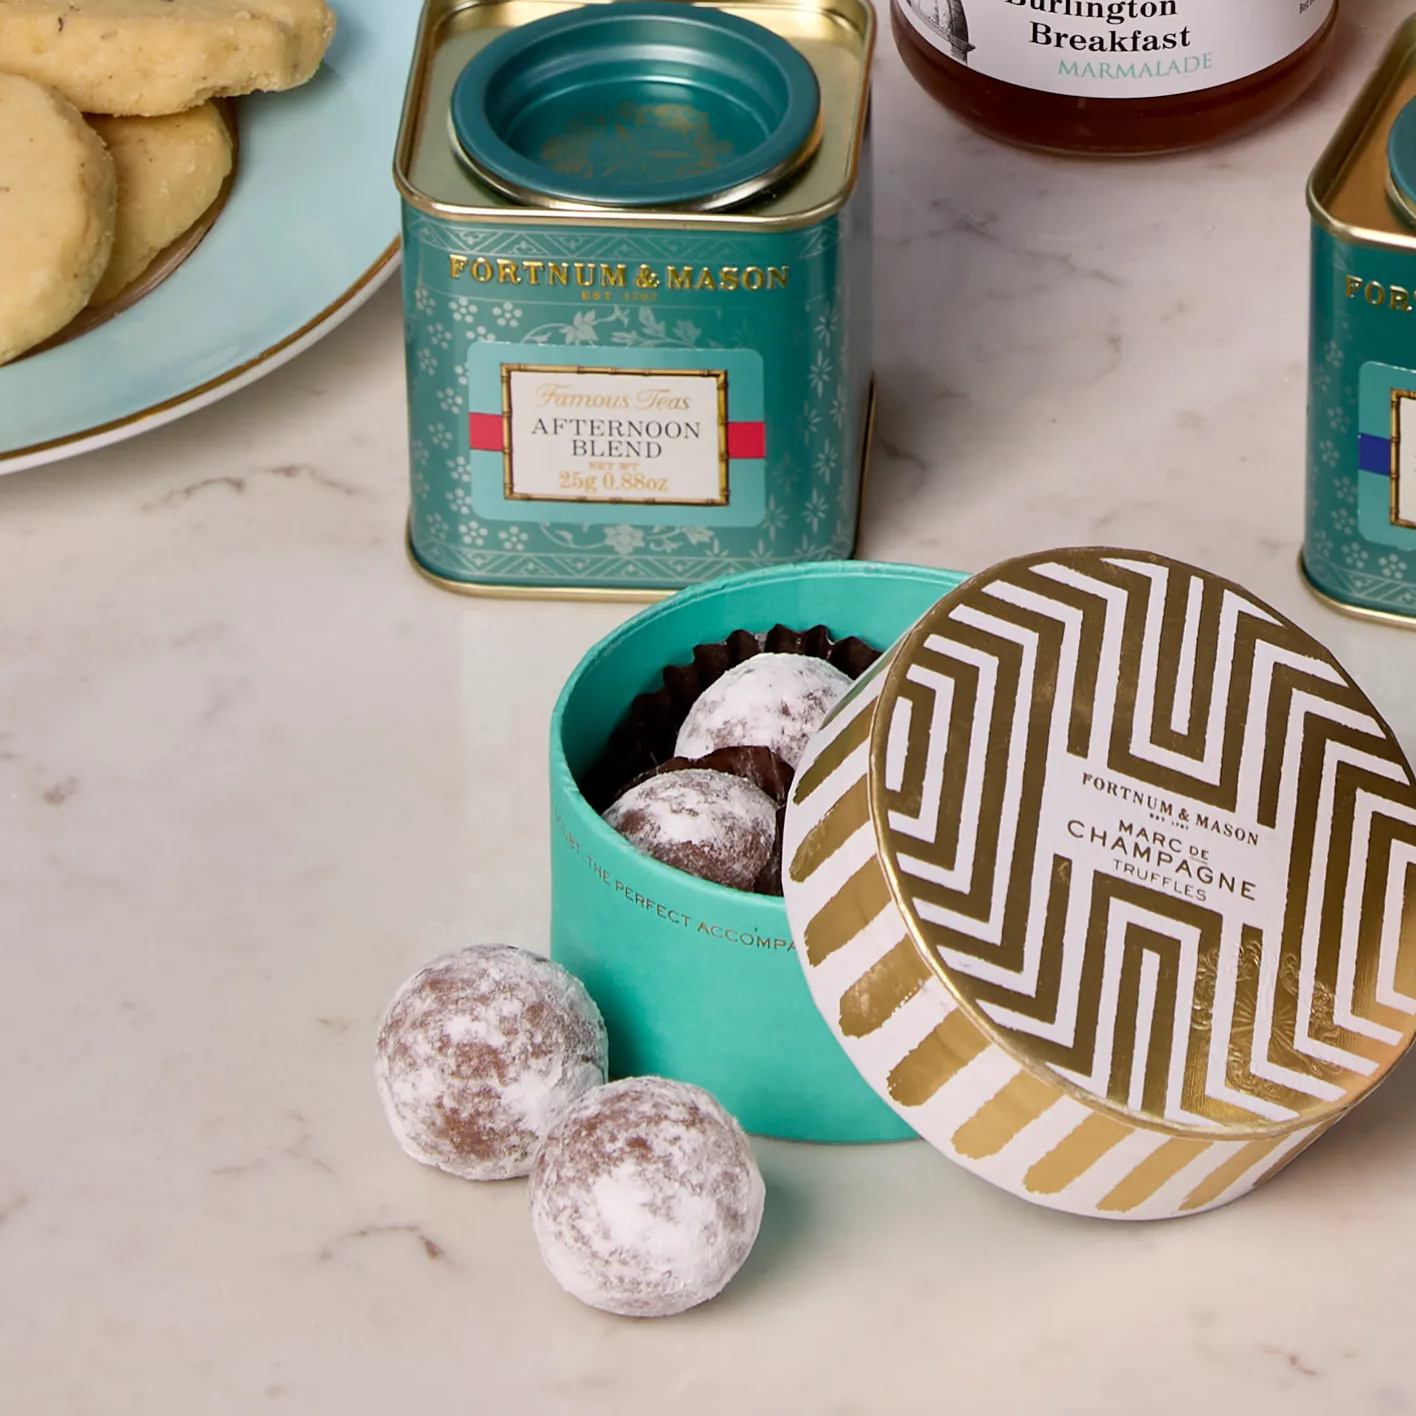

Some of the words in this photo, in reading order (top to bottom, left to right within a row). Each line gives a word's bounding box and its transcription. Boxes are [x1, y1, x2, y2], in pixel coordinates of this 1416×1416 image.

[1030, 21, 1191, 52] Breakfast
[1058, 52, 1213, 80] MARMALADE
[449, 254, 627, 289] FORTNUM
[635, 263, 660, 289] &
[667, 265, 790, 291] MASON
[535, 382, 631, 410] Famous
[635, 388, 692, 411] Teas
[531, 418, 700, 439] AFTERNOON
[572, 439, 662, 459] BLEND
[589, 461, 614, 470] NET
[619, 462, 640, 471] WT
[559, 471, 598, 494] 25g
[602, 473, 669, 492] 0.88oz
[1082, 772, 1173, 817] FORTNUM
[1178, 808, 1190, 822] &
[1196, 814, 1259, 846] MASON
[1118, 819, 1182, 853] MARC
[1189, 845, 1209, 860] DE
[1067, 819, 1257, 901] CHAMPAGNE
[587, 855, 611, 885] THE
[615, 880, 691, 928] PERFECT
[1113, 859, 1207, 902] TRUFFLES
